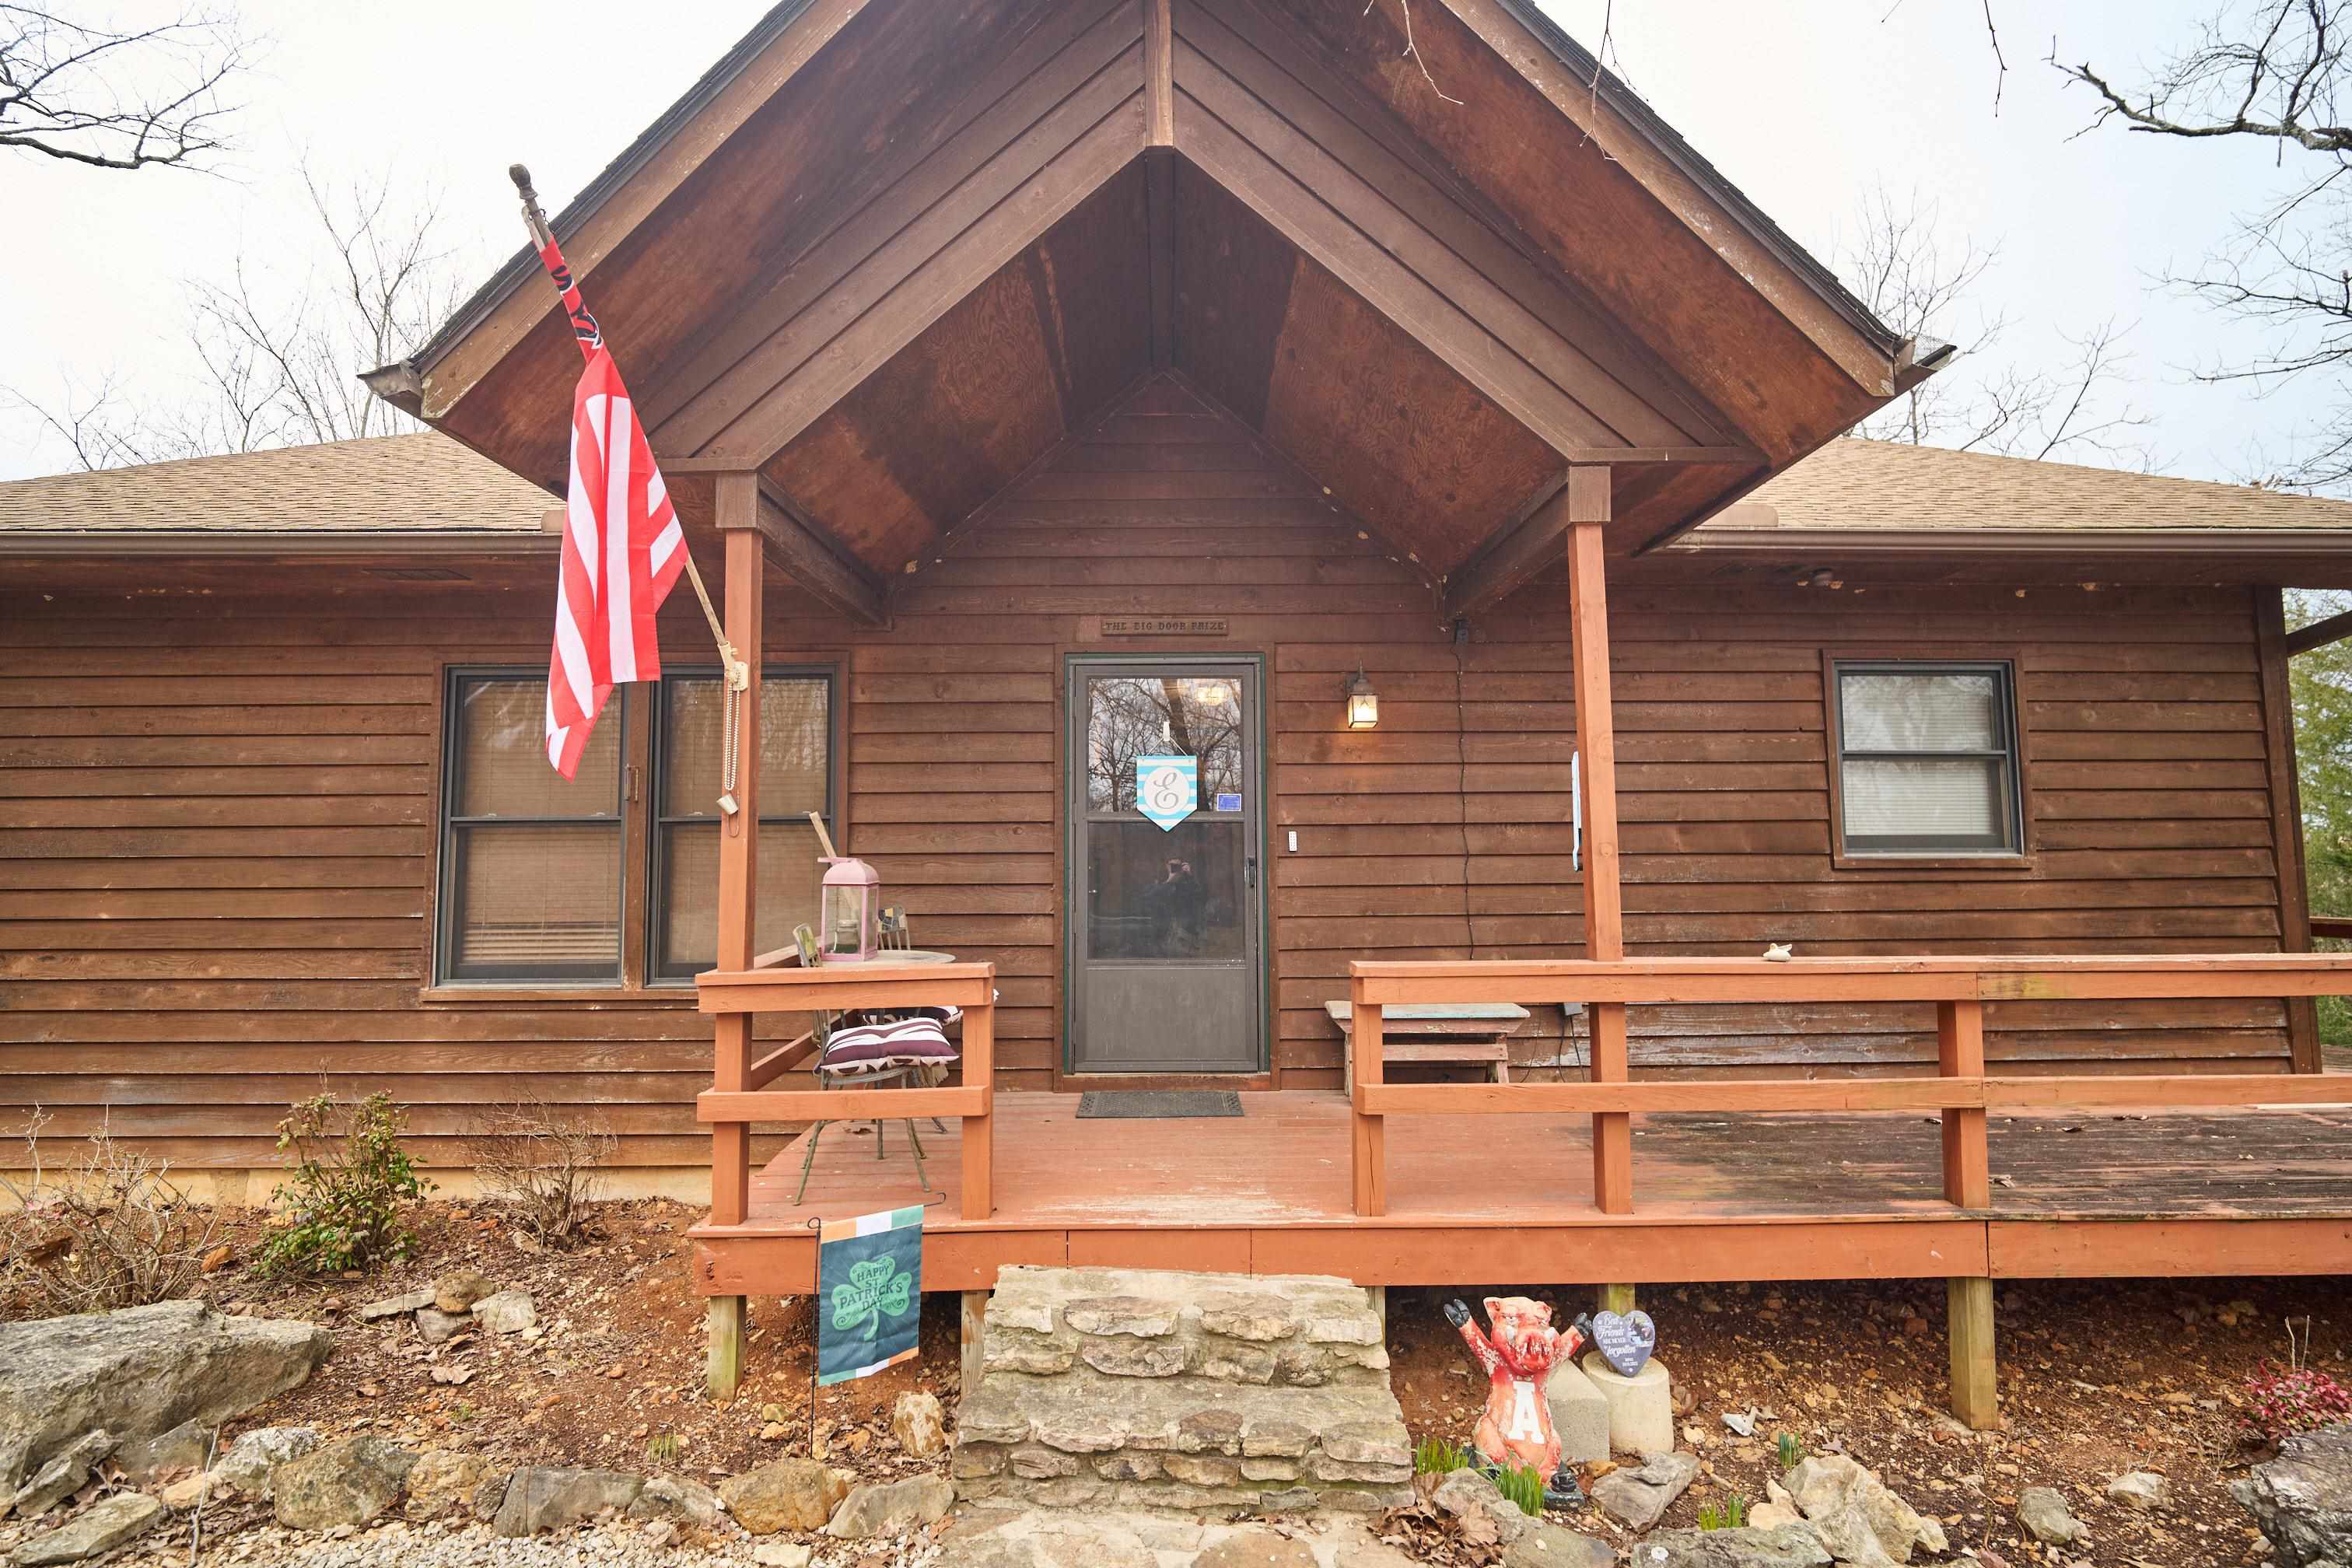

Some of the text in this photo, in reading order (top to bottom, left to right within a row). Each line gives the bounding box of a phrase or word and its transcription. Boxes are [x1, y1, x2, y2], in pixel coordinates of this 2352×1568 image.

[1153, 772, 1179, 810] E
[856, 1265, 890, 1283] HAPPY
[865, 1279, 882, 1288] ST.
[838, 1282, 903, 1309] PATRICK'S
[861, 1297, 884, 1312] DAY
[1507, 1380, 1545, 1444] A
